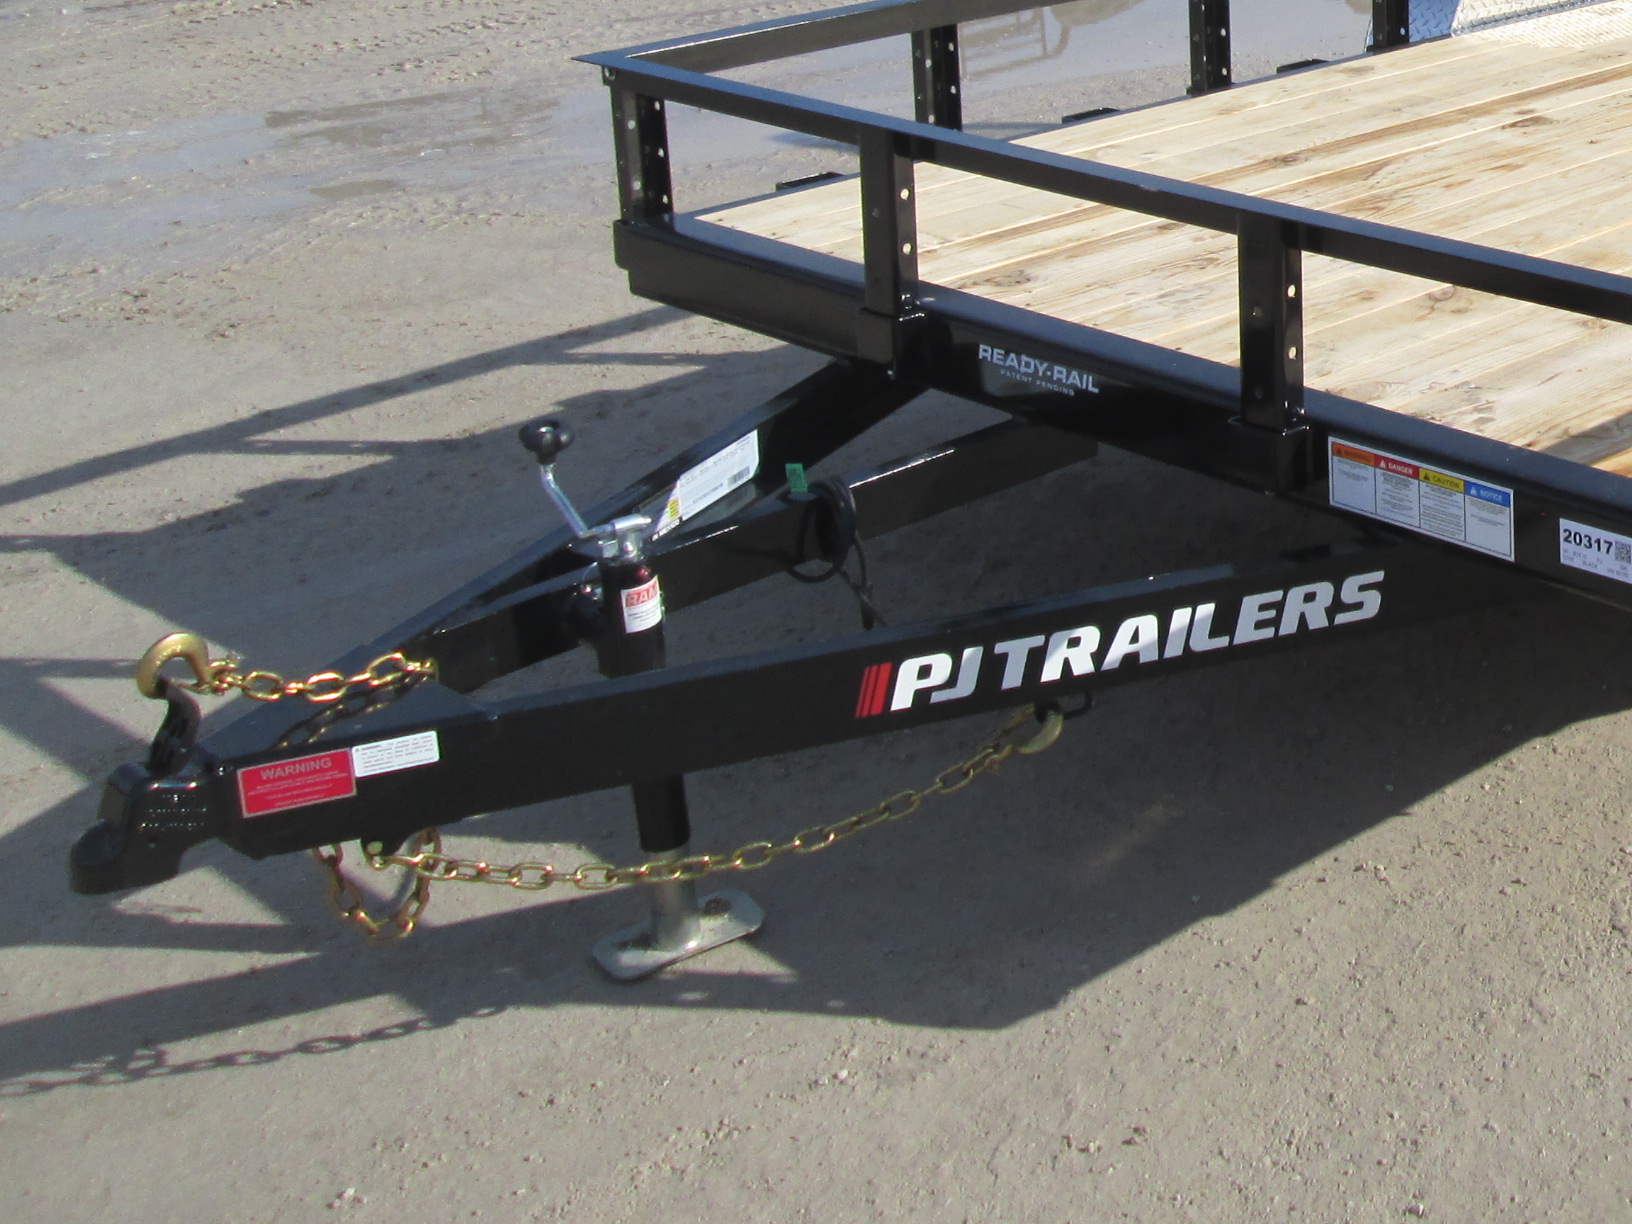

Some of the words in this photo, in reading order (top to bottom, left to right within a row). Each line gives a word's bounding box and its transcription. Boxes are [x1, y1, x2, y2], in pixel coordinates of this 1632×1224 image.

[978, 344, 1099, 394] READY-RAIL
[1001, 369, 1032, 383] PATENT
[1036, 379, 1075, 396] PENDING
[1388, 462, 1413, 476] DANGER
[1432, 475, 1460, 489] CAUTION
[1480, 489, 1503, 502] NOTICE
[1563, 528, 1613, 555] 20317
[890, 645, 983, 711] PJ
[994, 571, 1385, 690] TRAILERS
[260, 757, 332, 780] WARNING
